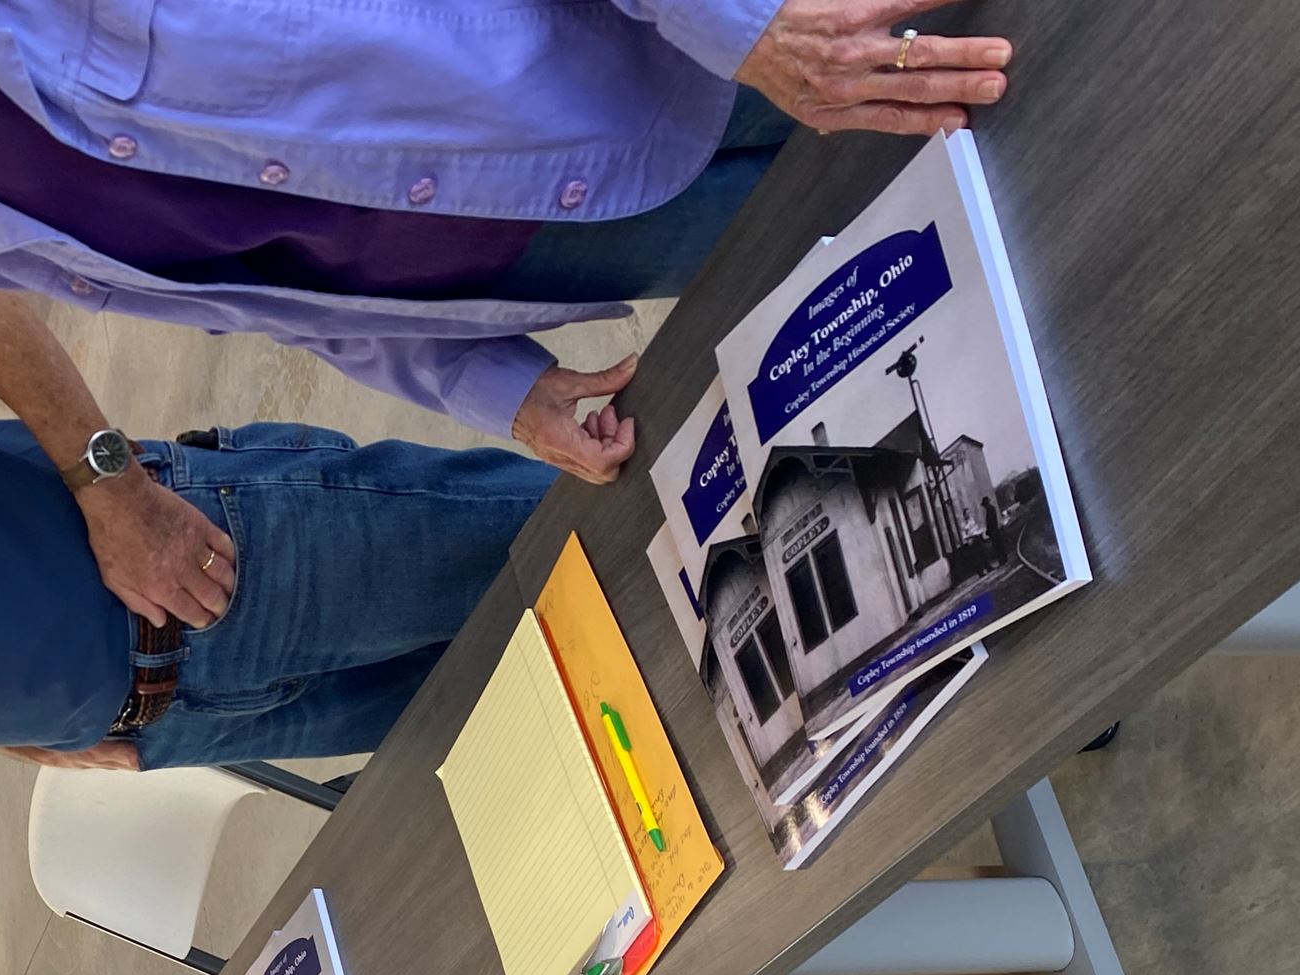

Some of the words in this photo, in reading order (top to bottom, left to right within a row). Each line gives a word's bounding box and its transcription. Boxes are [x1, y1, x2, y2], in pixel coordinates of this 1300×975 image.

[769, 342, 809, 381] Copley
[810, 289, 878, 345] Township,
[879, 255, 912, 287] Ohio
[808, 284, 844, 320] Images
[843, 266, 858, 287] of
[784, 390, 810, 413] Copley
[810, 359, 848, 392] Township
[848, 325, 886, 362] Historical
[886, 303, 915, 330] Society
[803, 362, 814, 376] In
[816, 347, 831, 366] the
[832, 304, 885, 352] Beginning
[700, 446, 729, 487] Copley
[716, 489, 735, 512] Copley
[857, 667, 880, 685] Copley
[880, 644, 916, 670] Township
[916, 622, 948, 648] founded
[958, 605, 976, 622] 1819
[837, 753, 865, 783] Township
